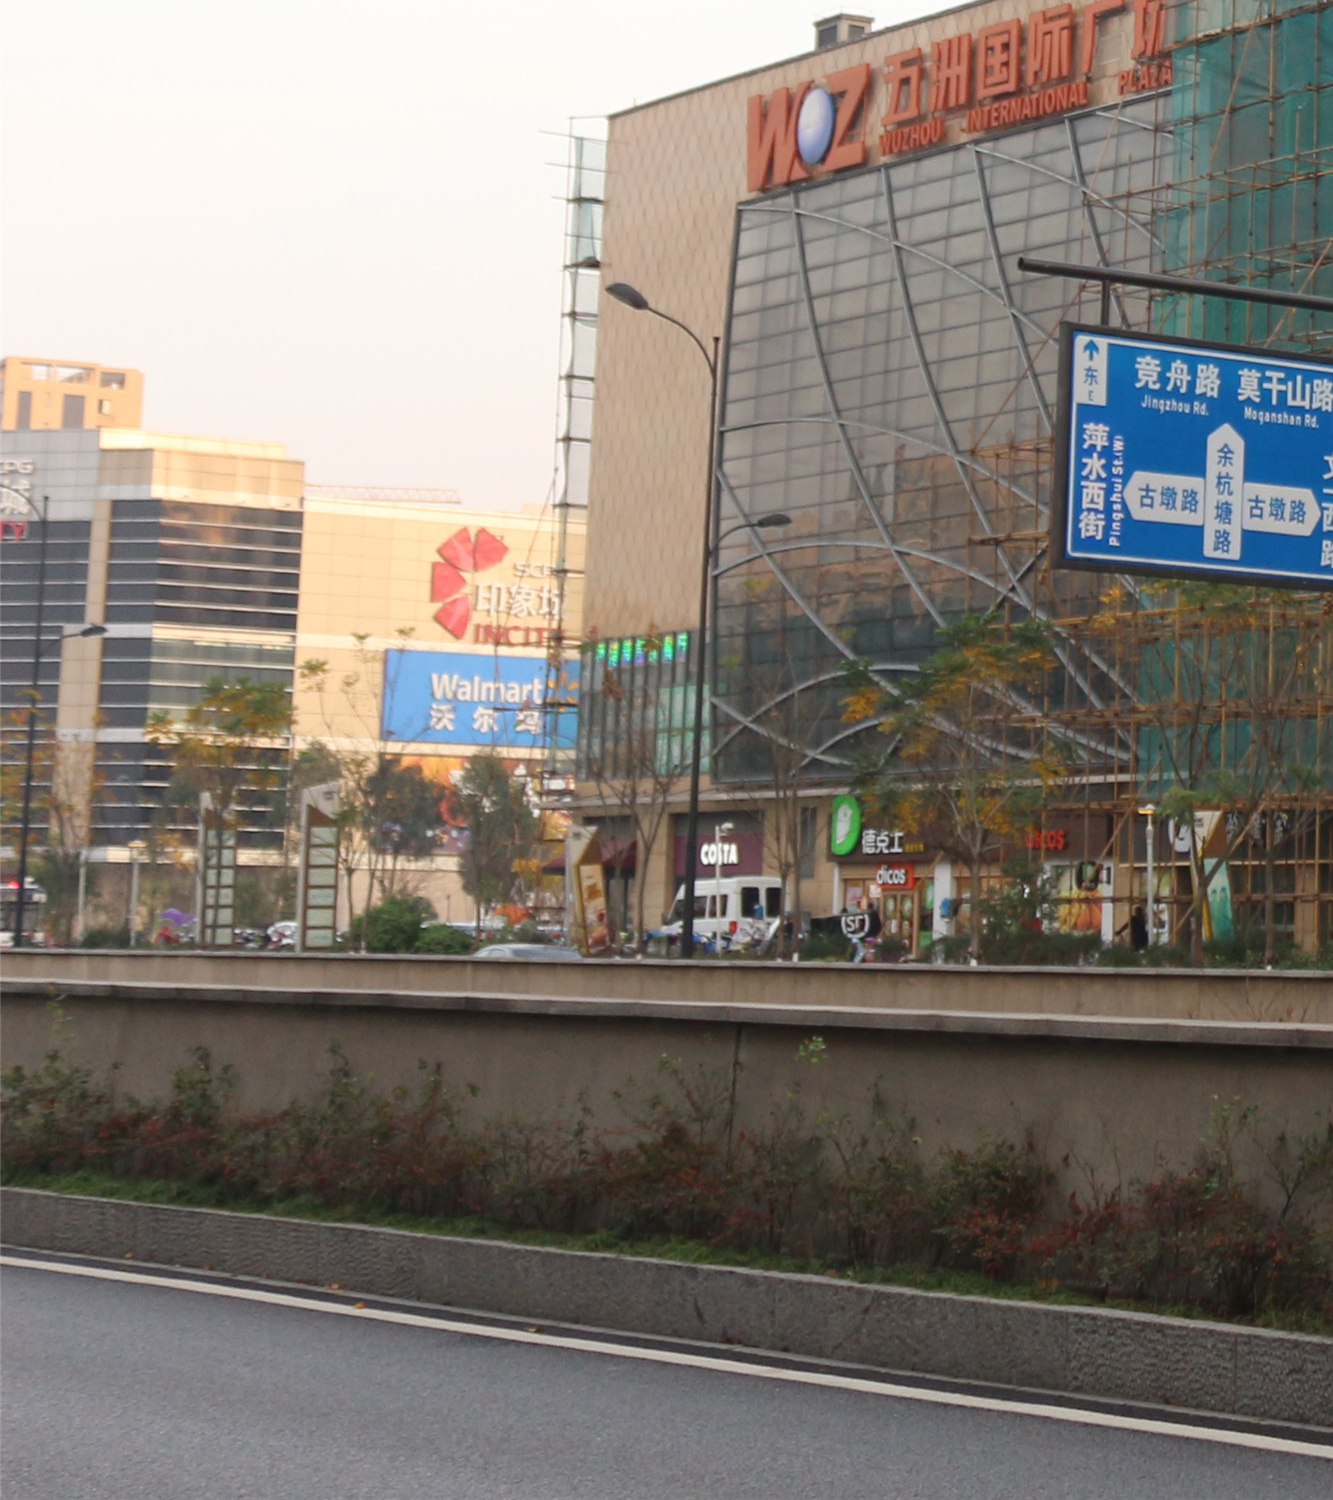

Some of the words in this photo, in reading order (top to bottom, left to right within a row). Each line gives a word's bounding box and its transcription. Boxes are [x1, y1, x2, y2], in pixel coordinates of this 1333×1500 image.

[879, 117, 945, 157] WUZHOU
[961, 81, 1088, 134] INTERNATIONAL
[1083, 366, 1099, 387] 东
[1134, 356, 1221, 399] 竞舟路
[1141, 395, 1191, 414] Jingzhou
[1193, 402, 1209, 417] Rd.
[1243, 406, 1302, 427] Moganshan
[1304, 414, 1320, 429] Rd.
[1078, 422, 1110, 542] 萍水西街
[1109, 479, 1123, 547] Pingshui
[1137, 483, 1200, 514] 古墩路
[1211, 443, 1236, 555] 余杭塘路
[1246, 494, 1307, 525] 古墩路
[431, 672, 544, 705] Walmart
[876, 864, 907, 885] dicos
